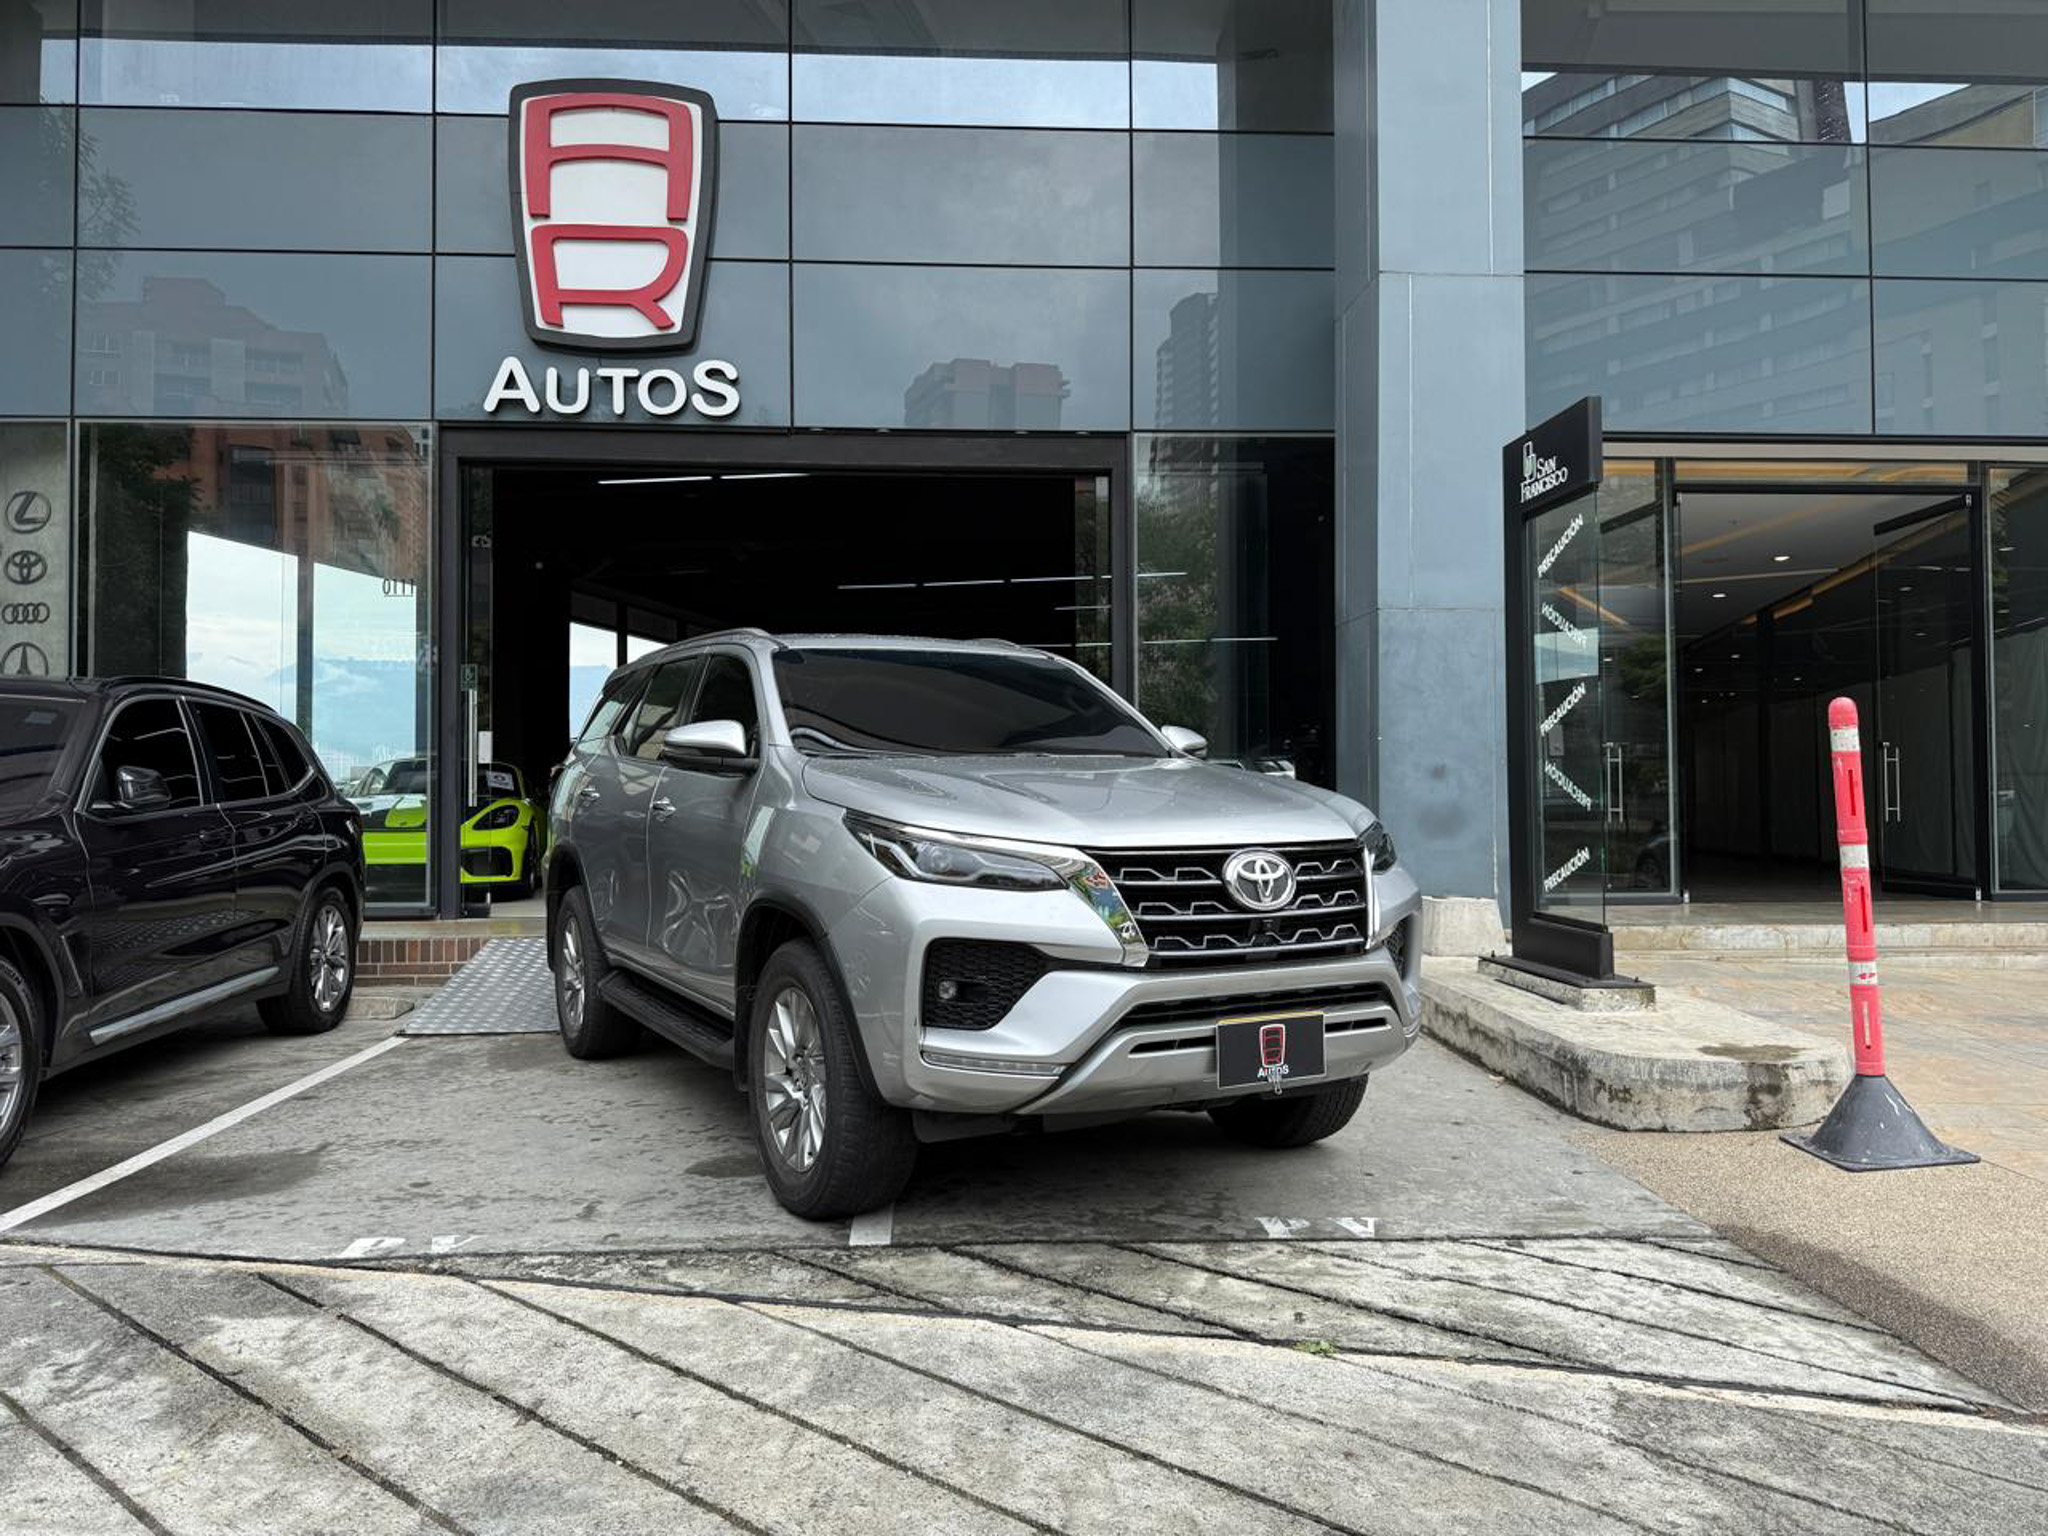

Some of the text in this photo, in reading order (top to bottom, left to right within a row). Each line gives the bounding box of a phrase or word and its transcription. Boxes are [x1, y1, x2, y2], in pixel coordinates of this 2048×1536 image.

[483, 356, 740, 416] AUTOS
[1520, 467, 1568, 503] FRANCISCO
[1537, 456, 1556, 479] SAN
[1537, 513, 1583, 578] PRECAUCIÓN
[1540, 682, 1586, 737] PRECAUCIÓN
[1544, 847, 1590, 892] PRECAUCIÓN
